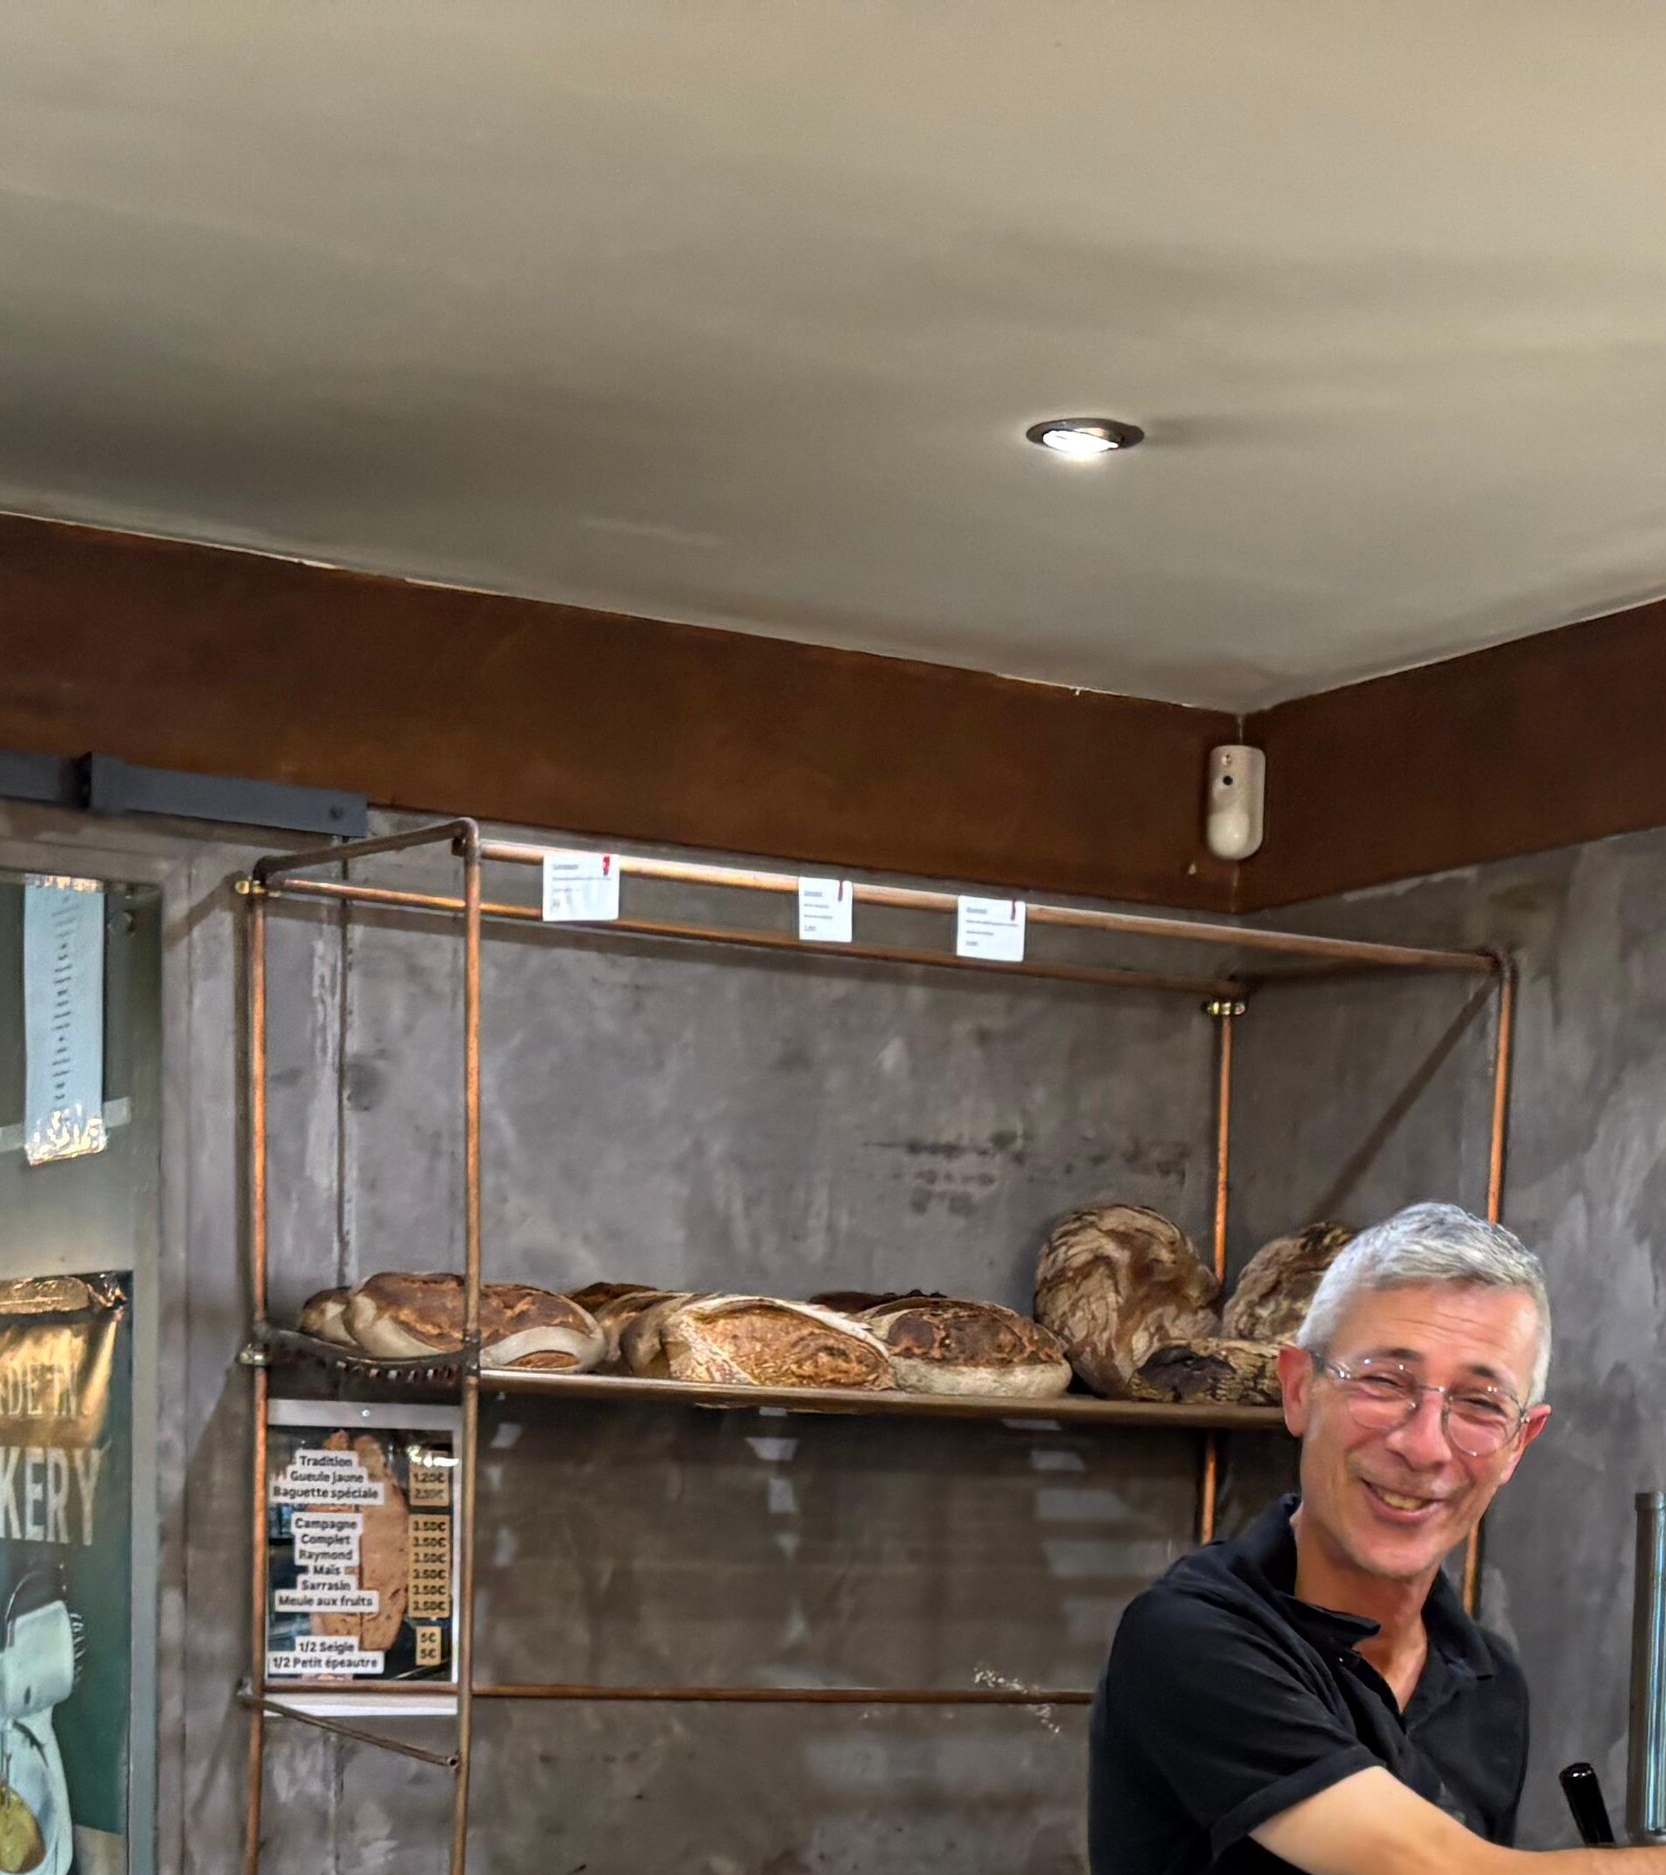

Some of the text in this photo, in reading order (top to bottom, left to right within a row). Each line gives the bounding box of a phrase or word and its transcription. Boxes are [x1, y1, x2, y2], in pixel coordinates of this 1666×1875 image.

[52, 1361, 79, 1420] IN
[299, 1455, 353, 1467] Tradition
[290, 1471, 364, 1485] Gueule jaune
[273, 1486, 380, 1500] Baguette spéciale
[294, 1517, 358, 1532] Campagne
[300, 1533, 351, 1547] Complet
[299, 1549, 353, 1563] Raymond
[312, 1564, 342, 1575] Maïs
[301, 1580, 352, 1591] Sarrasin
[278, 1595, 374, 1606] Meule aux fruits
[298, 1642, 356, 1655] 1/2 Seigle
[273, 1656, 378, 1670] 1/2 Petit épeautre
